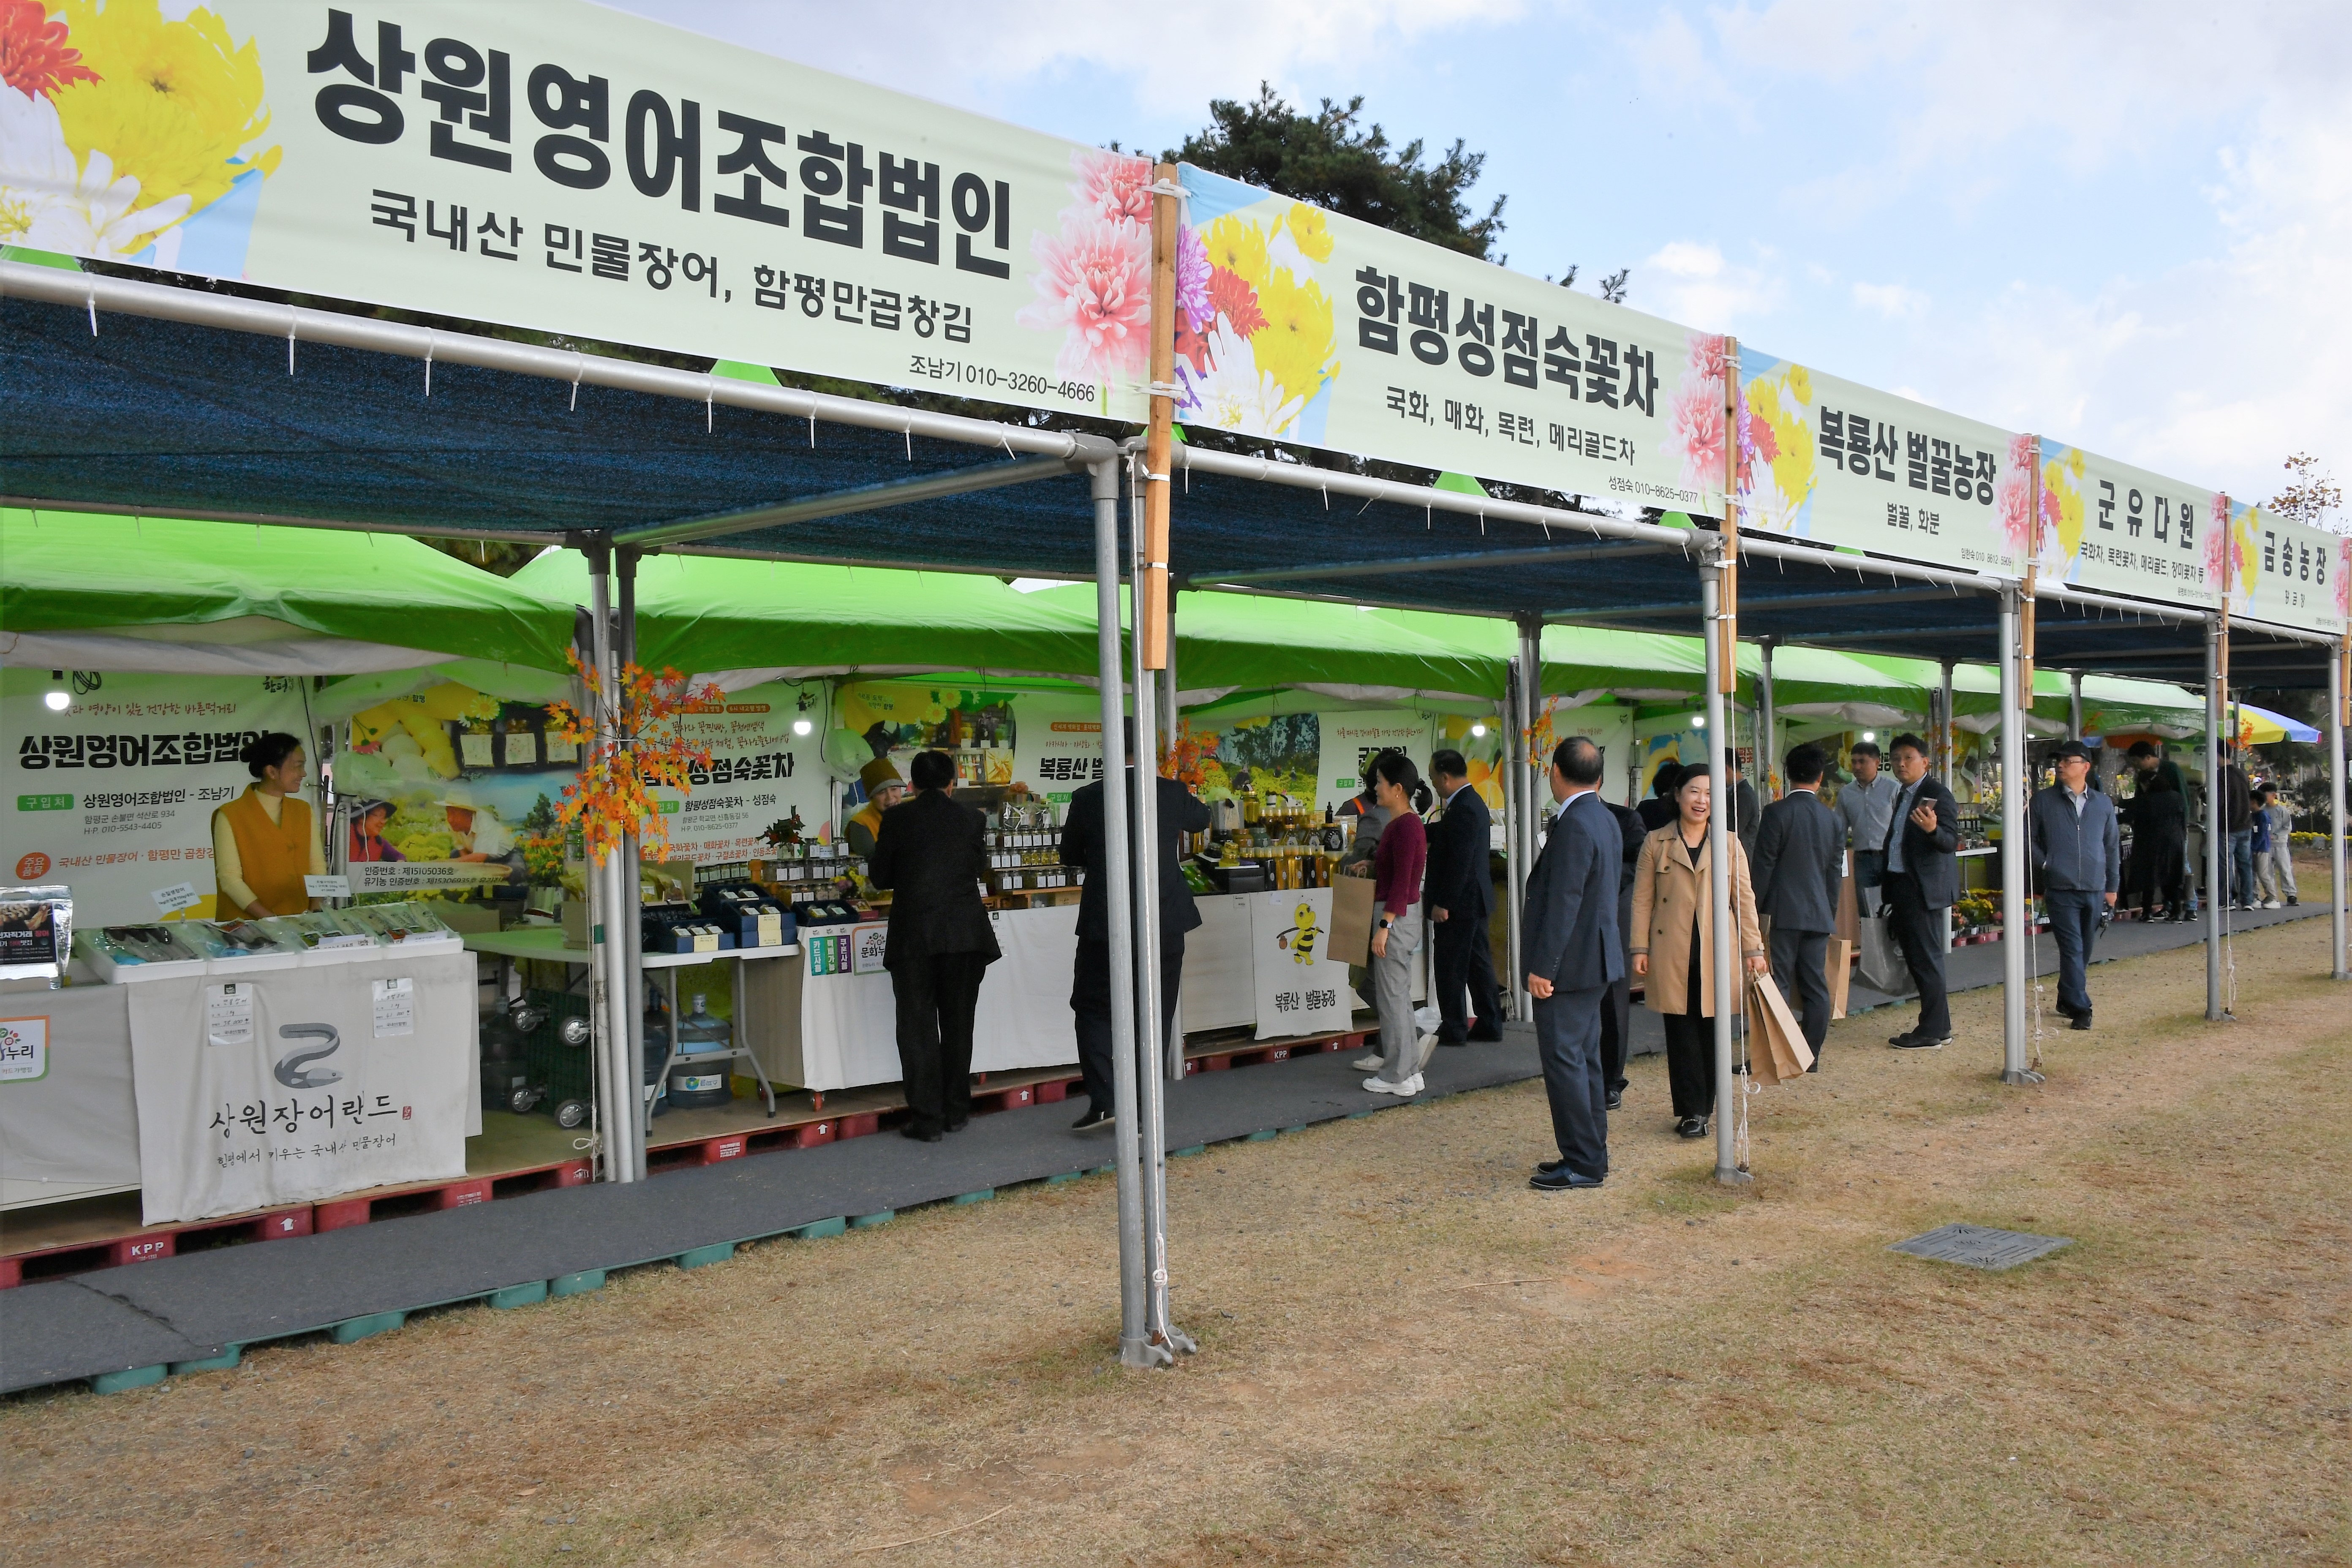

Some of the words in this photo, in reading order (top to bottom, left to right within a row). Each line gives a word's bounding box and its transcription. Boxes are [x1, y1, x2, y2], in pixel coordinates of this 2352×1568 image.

[307, 8, 1010, 280] 상원영어조합법인
[371, 189, 523, 261] 국내산
[545, 223, 732, 303] 민물장어,
[754, 264, 971, 343] 함평만곱창김
[1356, 265, 1659, 418] 함평성점숙꽃차
[909, 355, 961, 383] 조남기
[966, 364, 1096, 403] 010-3260-4666
[1386, 386, 1434, 426] 국화,
[1445, 398, 1489, 438] 매화,
[1498, 411, 1540, 449] 목련,
[1549, 422, 1635, 466] 메리골드차
[1818, 405, 1899, 483] 복룡산
[1907, 431, 1996, 506] 벌꿀농장
[1609, 475, 1633, 494] 성점숙
[1634, 481, 1698, 504] 010-8625-0377
[1887, 502, 1913, 532] 벌꿀,
[1918, 508, 1940, 535] 화분
[1961, 548, 1975, 561] 임한숙
[1976, 551, 1984, 561] 010
[2081, 542, 2105, 564] 국화차,
[2108, 547, 2138, 571] 목련꽃차,
[2141, 555, 2169, 577] 메리골드,
[2172, 561, 2197, 582] 장미꽃차
[2198, 567, 2204, 583] 등
[89, 702, 121, 716] 영양이
[126, 704, 143, 716] 있는
[147, 703, 181, 716] 건강한
[1040, 758, 1088, 780] 복룡산
[26, 797, 65, 808] 구입처
[83, 789, 185, 808] 상원영어조합법인
[198, 787, 235, 801] 조남기
[685, 796, 743, 812] 함평성점숙꽃차
[752, 794, 776, 806] 성점숙
[84, 815, 108, 824] 함평군
[111, 813, 134, 823] 손불면
[136, 811, 158, 819] 석산로
[694, 822, 738, 832] 010-8625-0377
[102, 822, 162, 833] 010-5543-4405
[704, 839, 730, 849] 매화꽃차
[753, 847, 777, 857] 인동초꽃
[59, 856, 92, 867] 국내산
[95, 851, 138, 864] 민물장어
[147, 848, 181, 862] 함평만
[365, 866, 395, 876] 인증번호
[403, 866, 454, 876] 제15105036호
[364, 877, 387, 887] 유기농
[389, 877, 421, 886] 인증번호
[861, 944, 885, 958] 문화누
[1275, 991, 1300, 1013] 복룡산
[1306, 989, 1336, 1010] 벌꿀농장
[1274, 1050, 1288, 1059] KPP
[210, 1094, 397, 1138] 상원장어란드
[269, 1147, 305, 1162] 키우는
[352, 1133, 396, 1152] 민물장어
[131, 1242, 164, 1256] KPP
